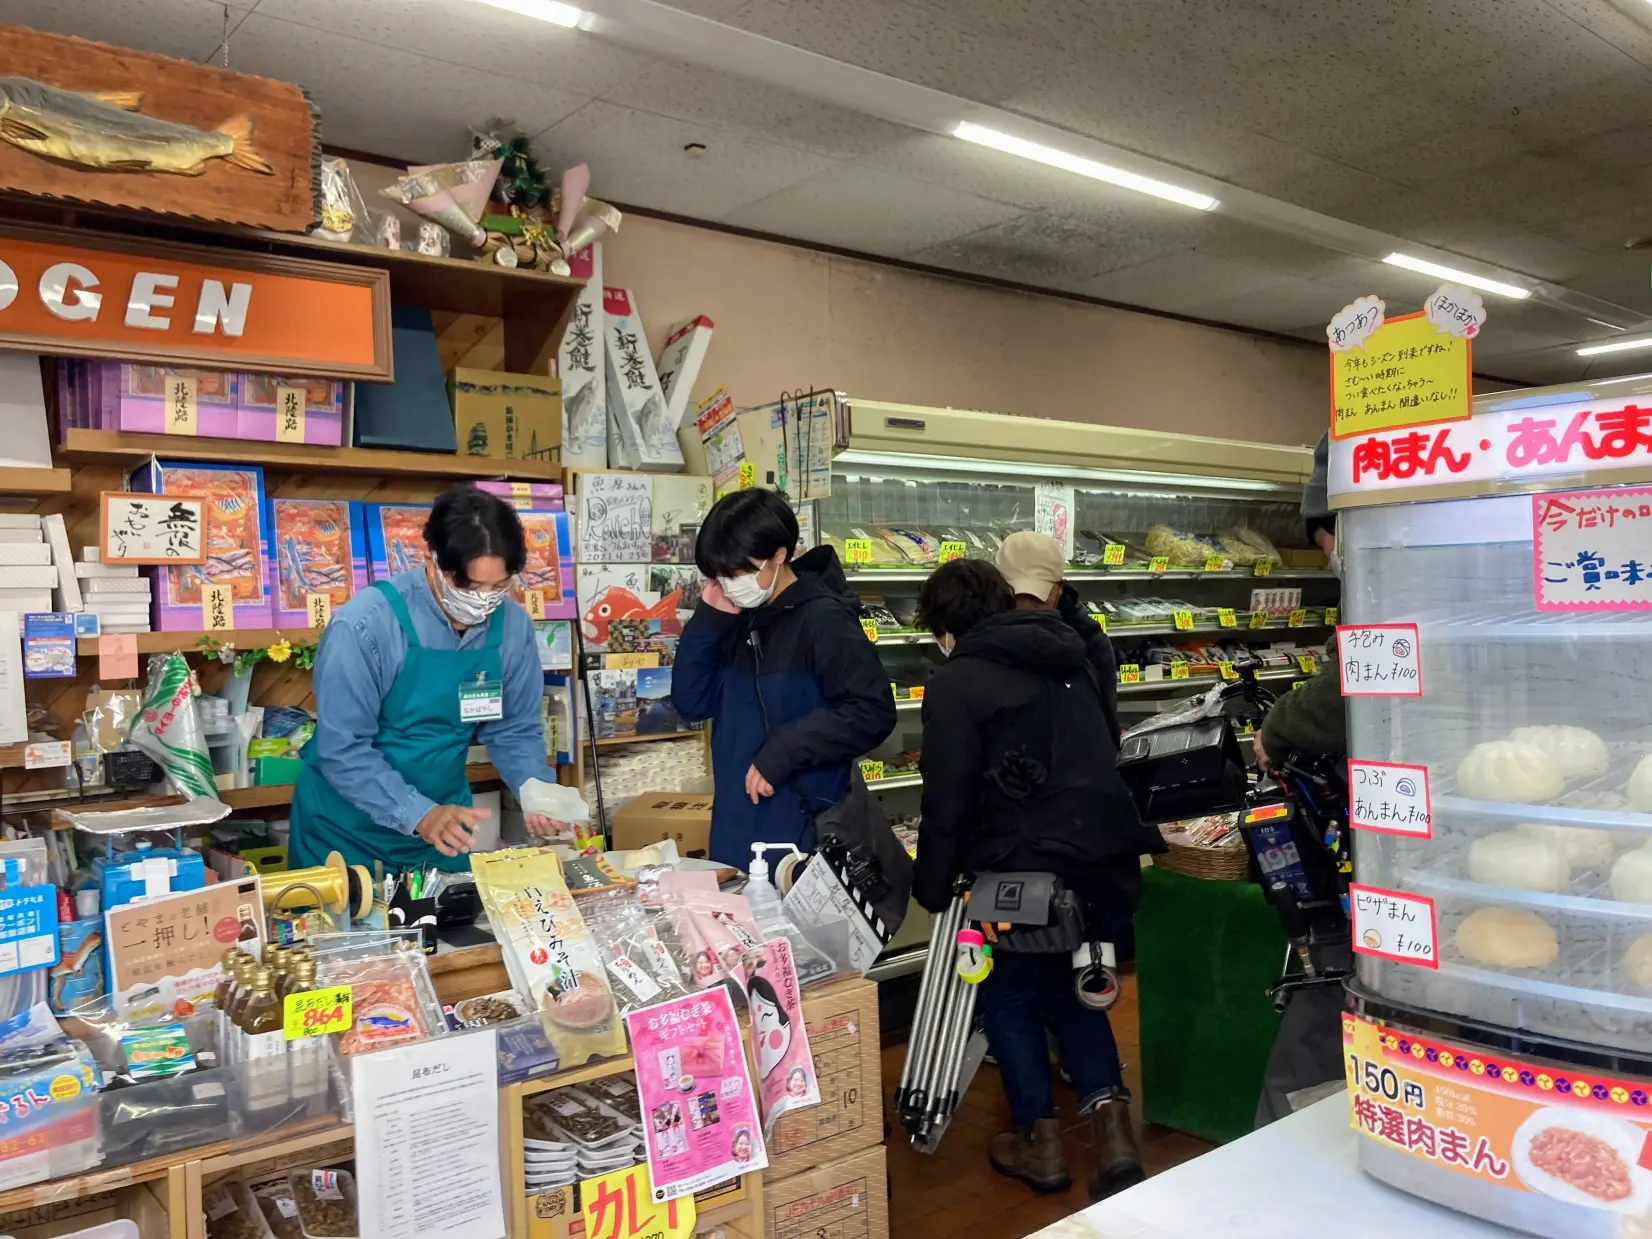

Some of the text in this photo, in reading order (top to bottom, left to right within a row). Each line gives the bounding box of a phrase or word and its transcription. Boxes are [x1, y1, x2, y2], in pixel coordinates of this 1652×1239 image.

[1333, 306, 1378, 343] あつあつ
[1435, 295, 1477, 327] ほかほか
[614, 327, 653, 389] 新巻鮭
[174, 381, 189, 423] 北陸路
[283, 392, 299, 431] 北陸路
[1364, 400, 1396, 415] あんまん
[1544, 551, 1652, 592] ご賞味
[211, 590, 226, 627] 北陸路
[1353, 768, 1387, 787] つぶ
[1356, 894, 1415, 922] ピザまん
[1397, 934, 1432, 955] ¥100
[303, 1005, 344, 1027] 864
[412, 1063, 451, 1080] 昆布だし
[1350, 1055, 1424, 1108] 150円
[1354, 1095, 1508, 1176] 特選肉まん
